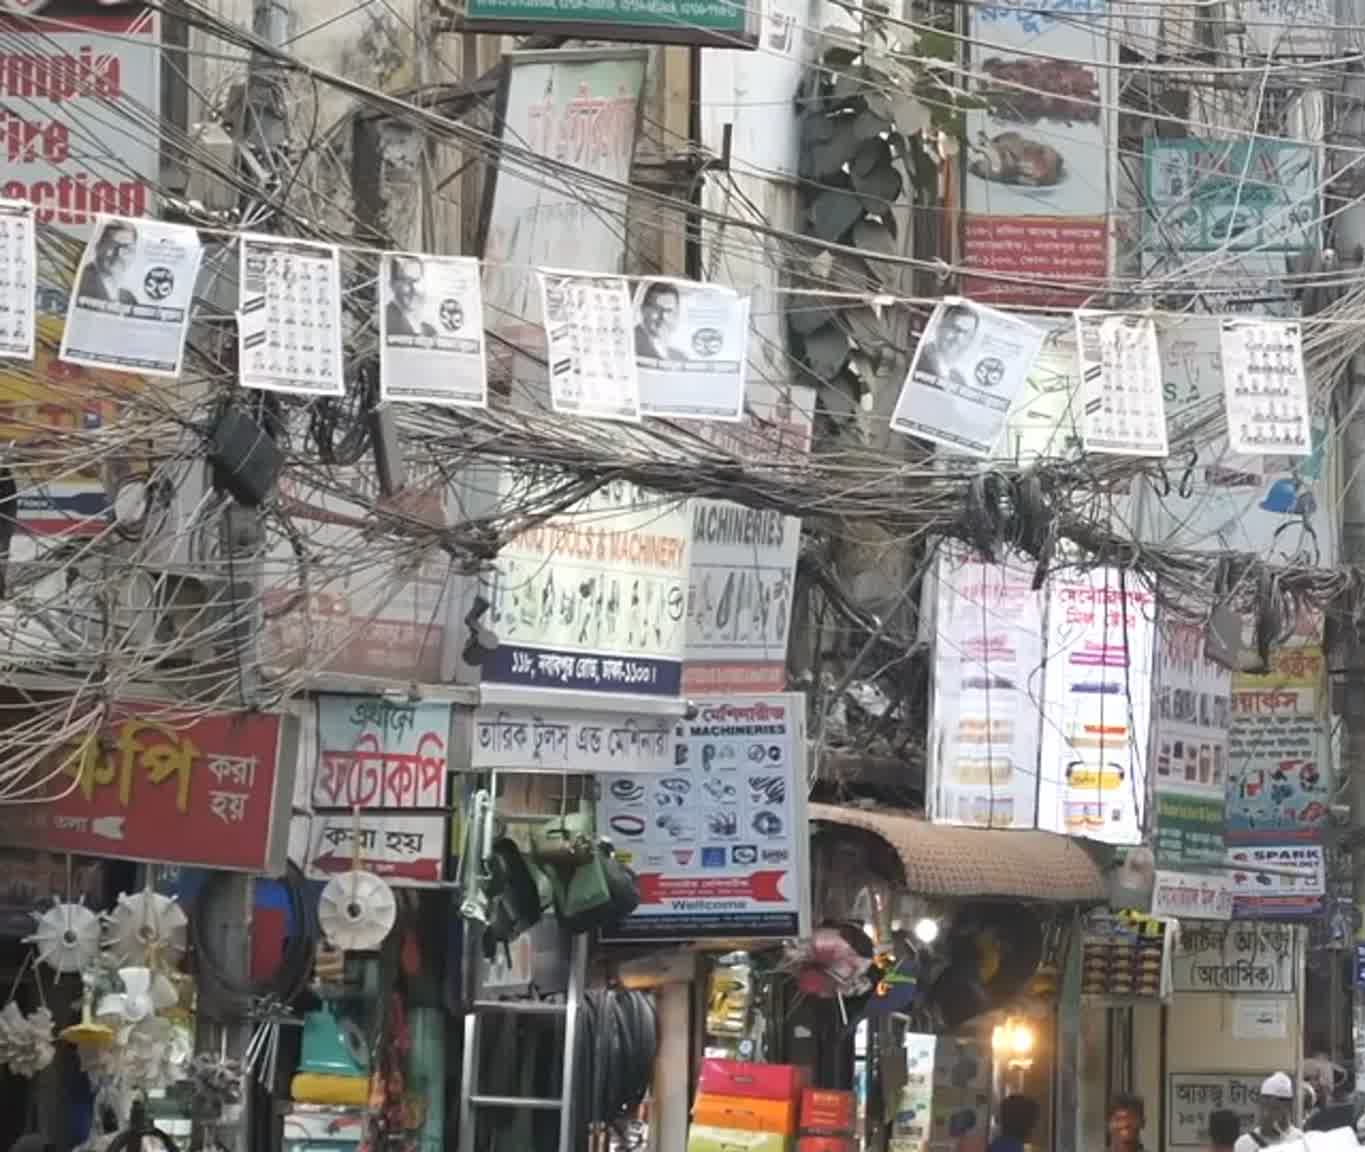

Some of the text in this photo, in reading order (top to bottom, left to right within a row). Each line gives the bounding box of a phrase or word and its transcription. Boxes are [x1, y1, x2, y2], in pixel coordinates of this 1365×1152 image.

[0, 45, 121, 103] mpia
[0, 108, 70, 164] ire
[2, 172, 147, 224] ection
[693, 506, 785, 545] ACHINERIES
[691, 723, 787, 736] MACHINERIES
[207, 753, 258, 788] করা
[207, 791, 250, 824] হয়
[1253, 850, 1319, 861] SPARK
